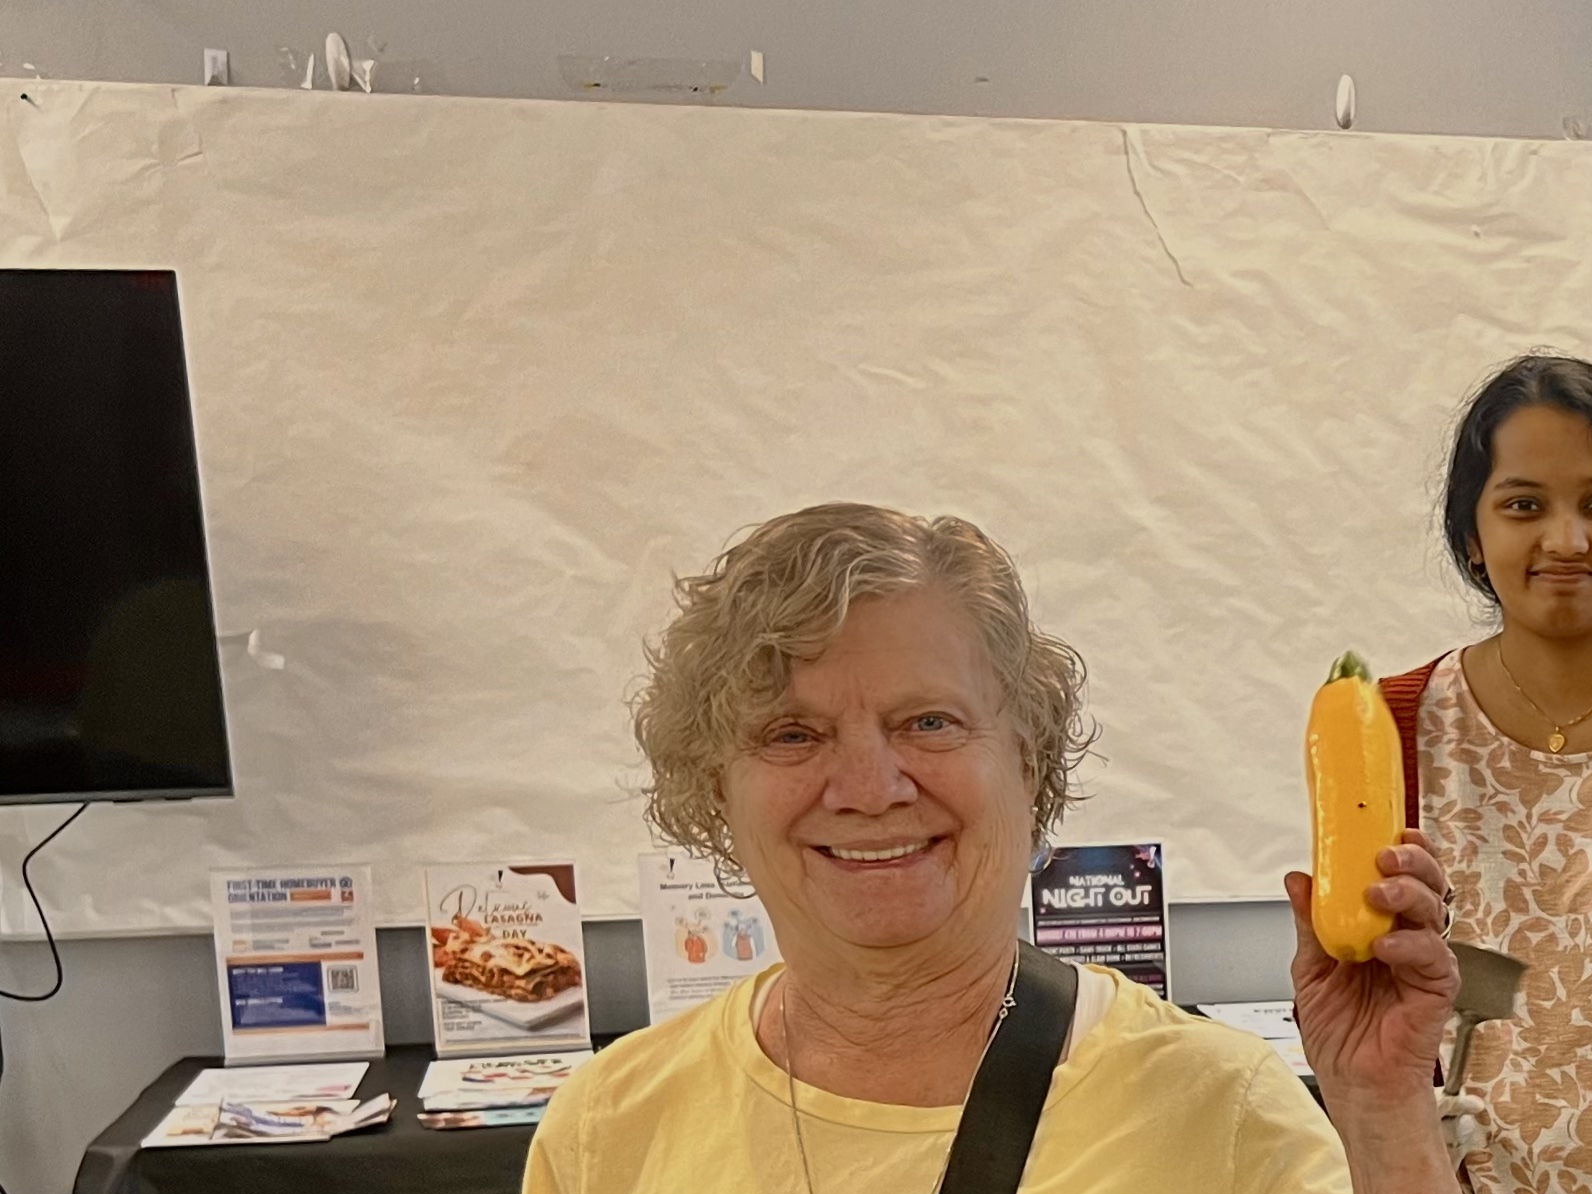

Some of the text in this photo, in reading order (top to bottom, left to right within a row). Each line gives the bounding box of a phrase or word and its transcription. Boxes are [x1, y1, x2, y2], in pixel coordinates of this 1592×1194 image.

[1068, 874, 1125, 887] NATIONAL
[1041, 885, 1152, 909] NIGHT OUT
[484, 912, 544, 925] LASAGNA
[502, 929, 527, 940] DAY
